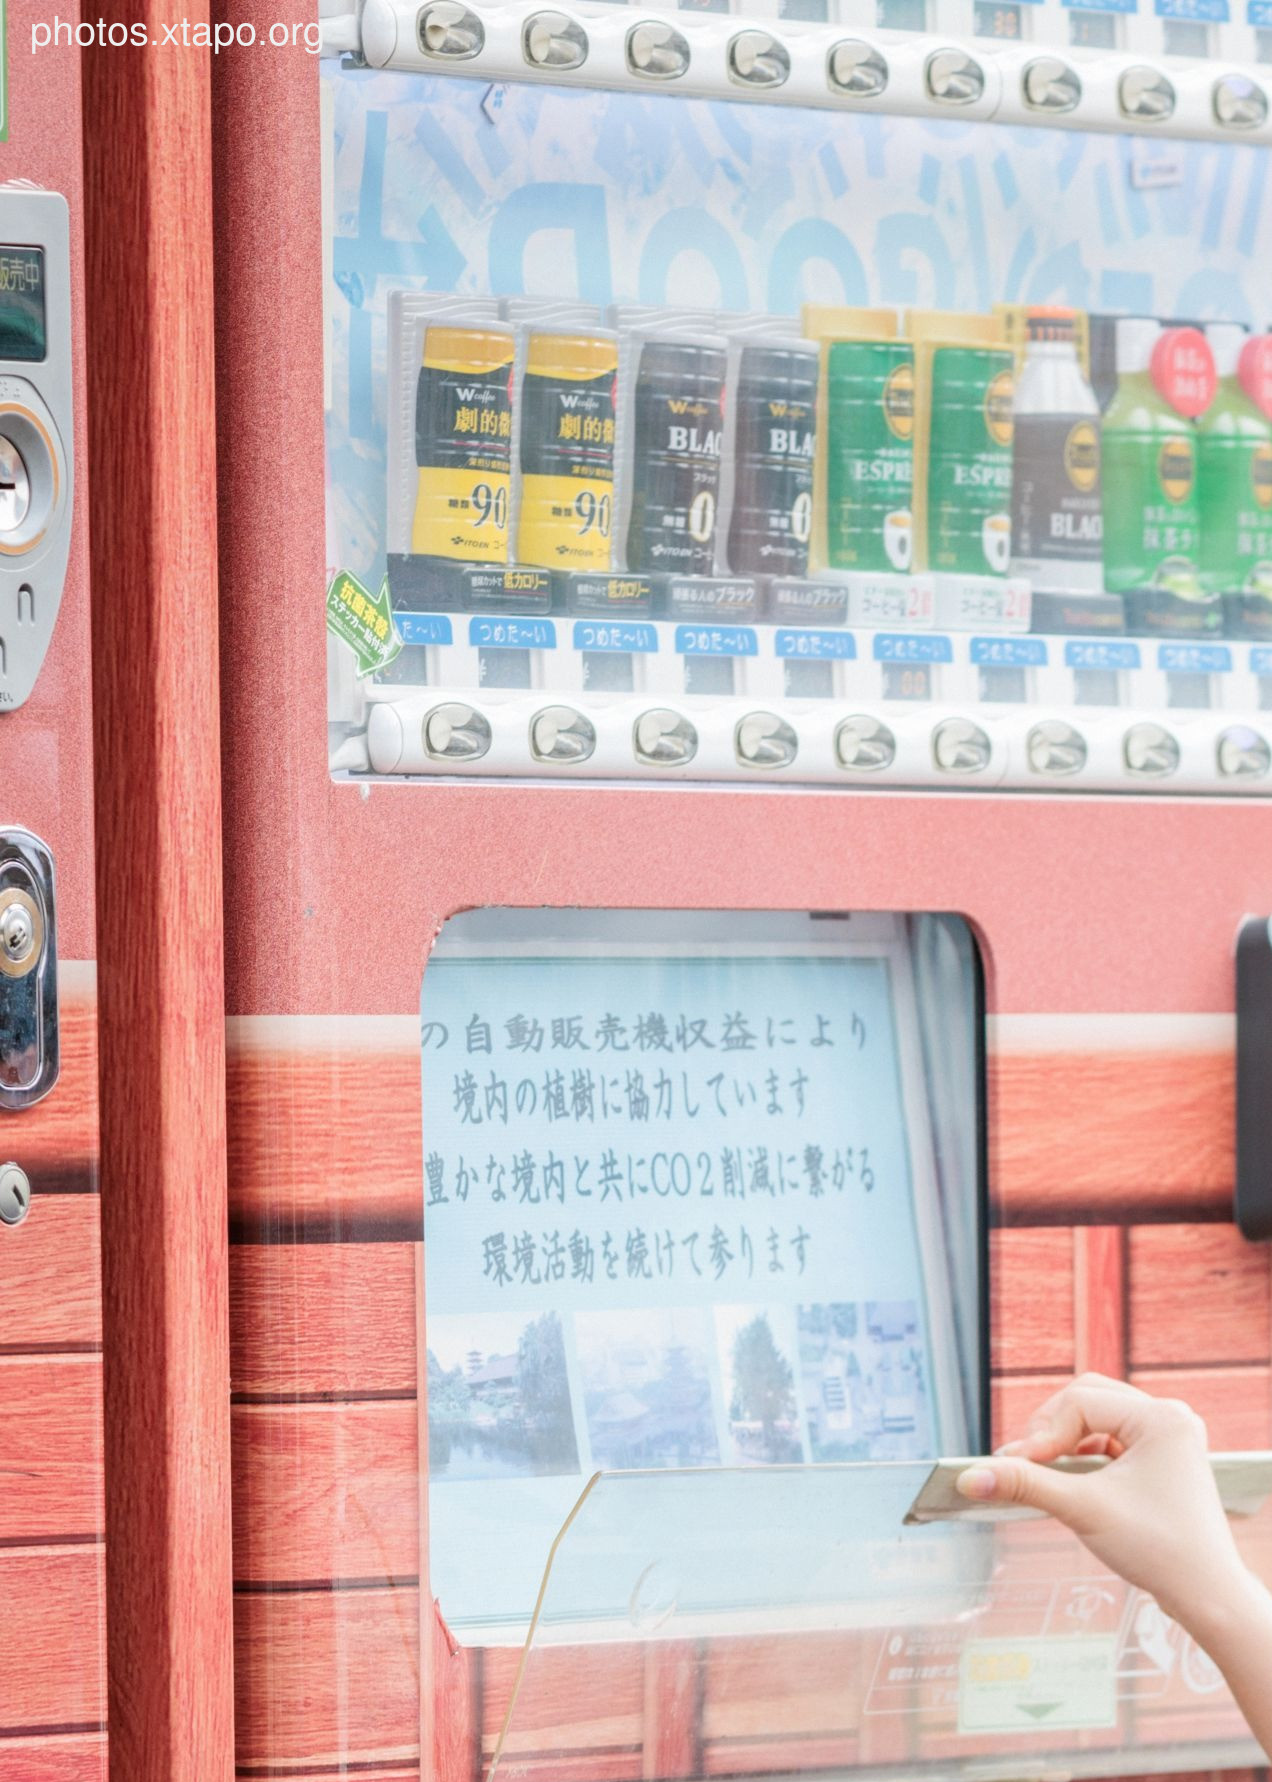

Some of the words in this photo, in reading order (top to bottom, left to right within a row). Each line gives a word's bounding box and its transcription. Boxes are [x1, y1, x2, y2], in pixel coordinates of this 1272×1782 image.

[471, 484, 507, 530] 90
[452, 1067, 811, 1125] 境内の植樹に協力しています
[482, 1224, 811, 1288] 環境活動を続けて参ります
